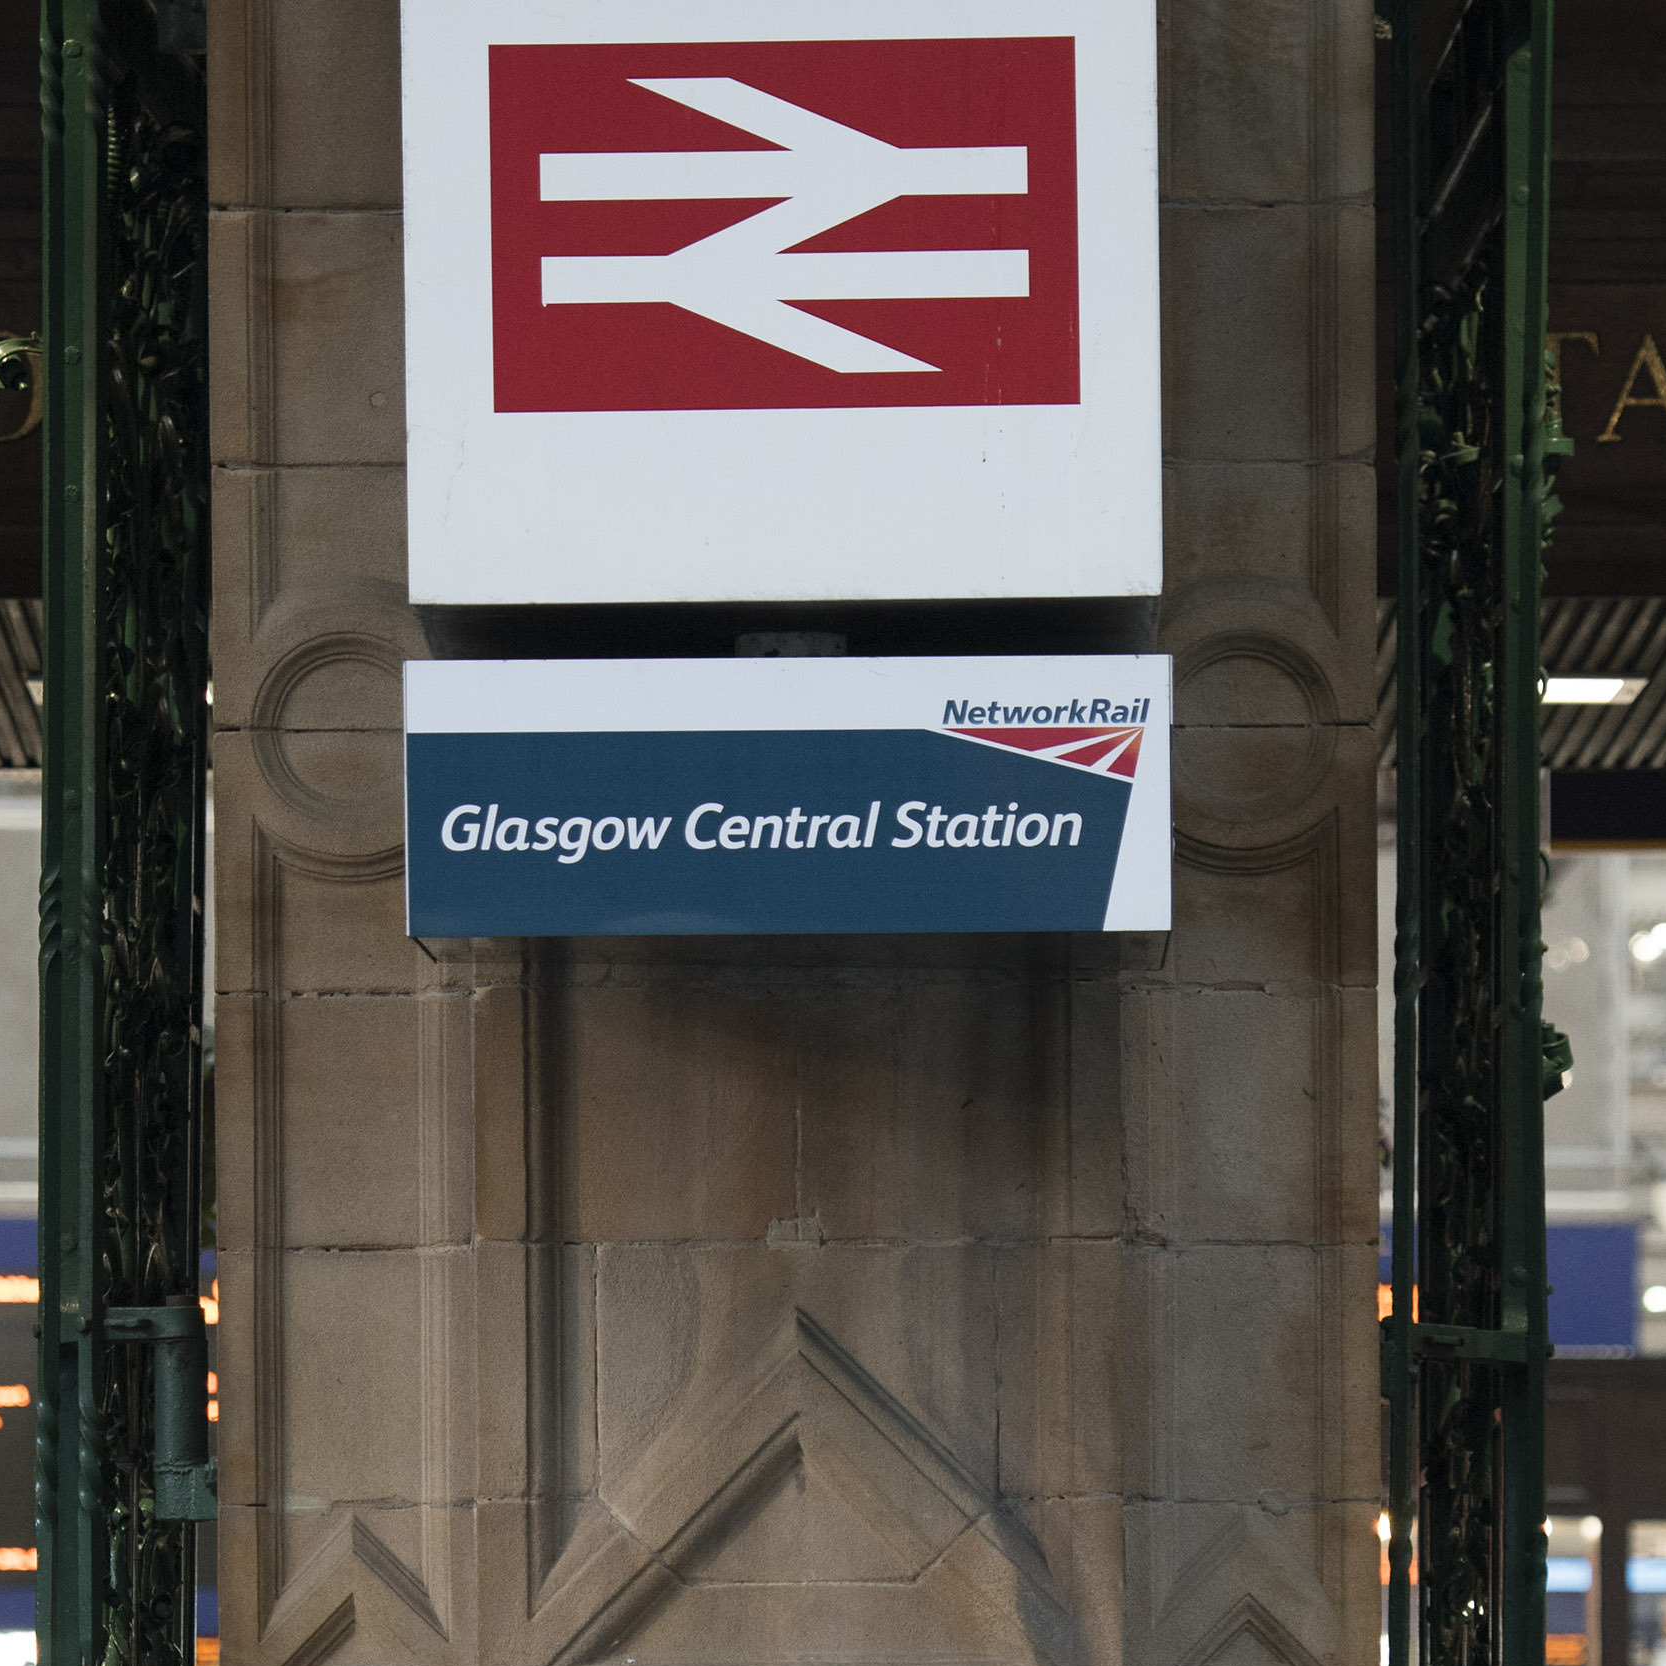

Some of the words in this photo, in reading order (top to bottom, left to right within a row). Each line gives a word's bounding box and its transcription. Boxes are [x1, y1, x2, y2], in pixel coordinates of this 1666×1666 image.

[941, 697, 1151, 727] NetworkRail
[440, 803, 672, 865] Glasgow
[684, 800, 883, 851] Central
[890, 800, 1084, 848] Station
